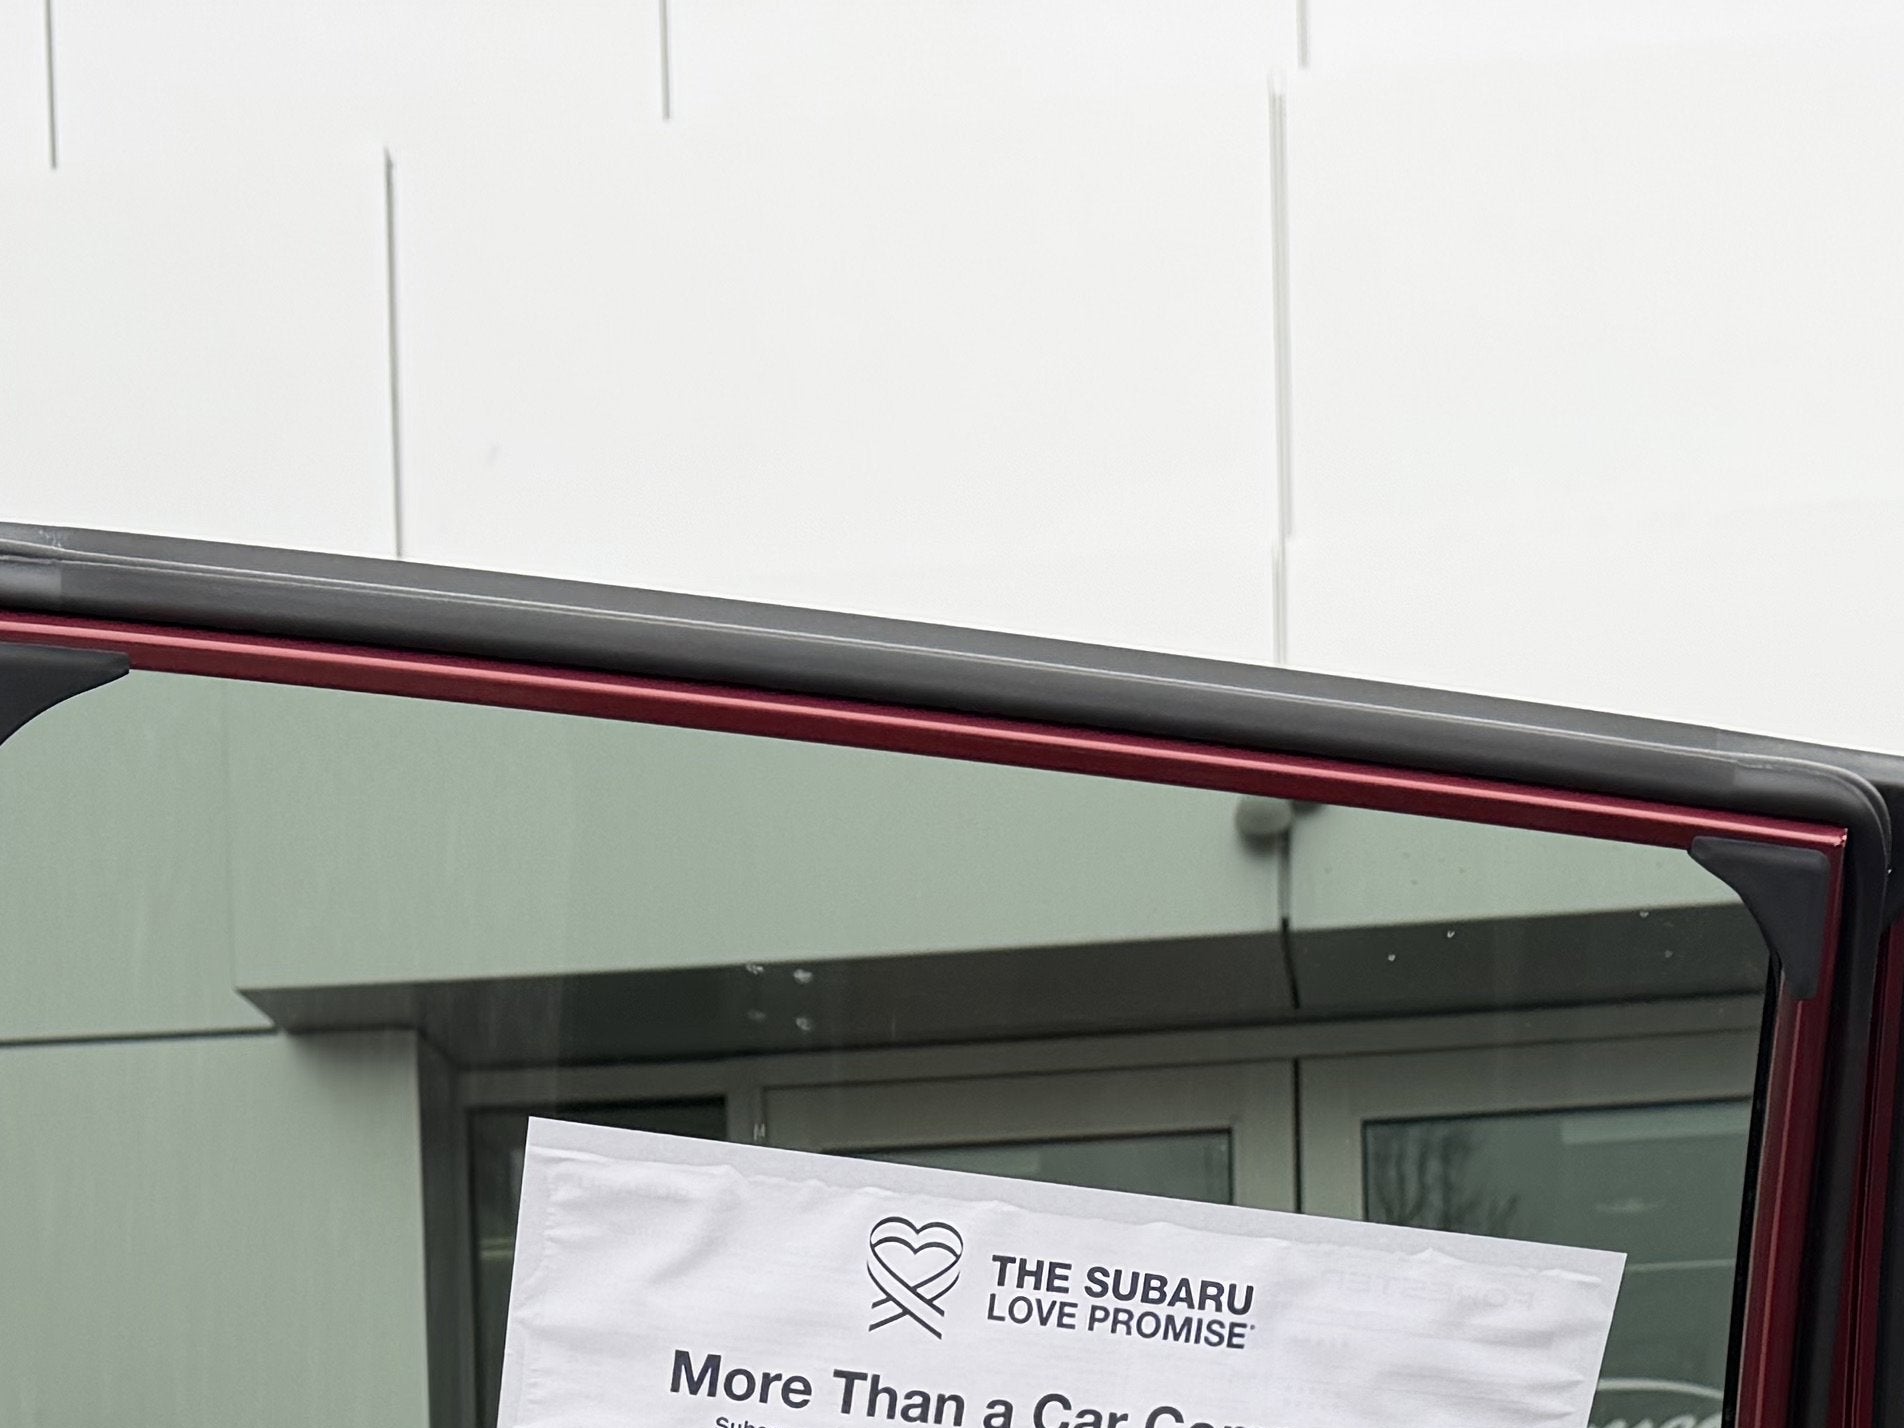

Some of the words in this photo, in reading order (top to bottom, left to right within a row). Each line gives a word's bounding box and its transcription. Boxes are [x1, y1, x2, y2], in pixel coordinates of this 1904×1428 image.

[985, 1291, 1080, 1332] LOVE
[990, 1253, 1074, 1296] THE
[1082, 1264, 1256, 1317] SUBARU
[668, 1348, 814, 1411] More
[831, 1367, 966, 1428] Than
